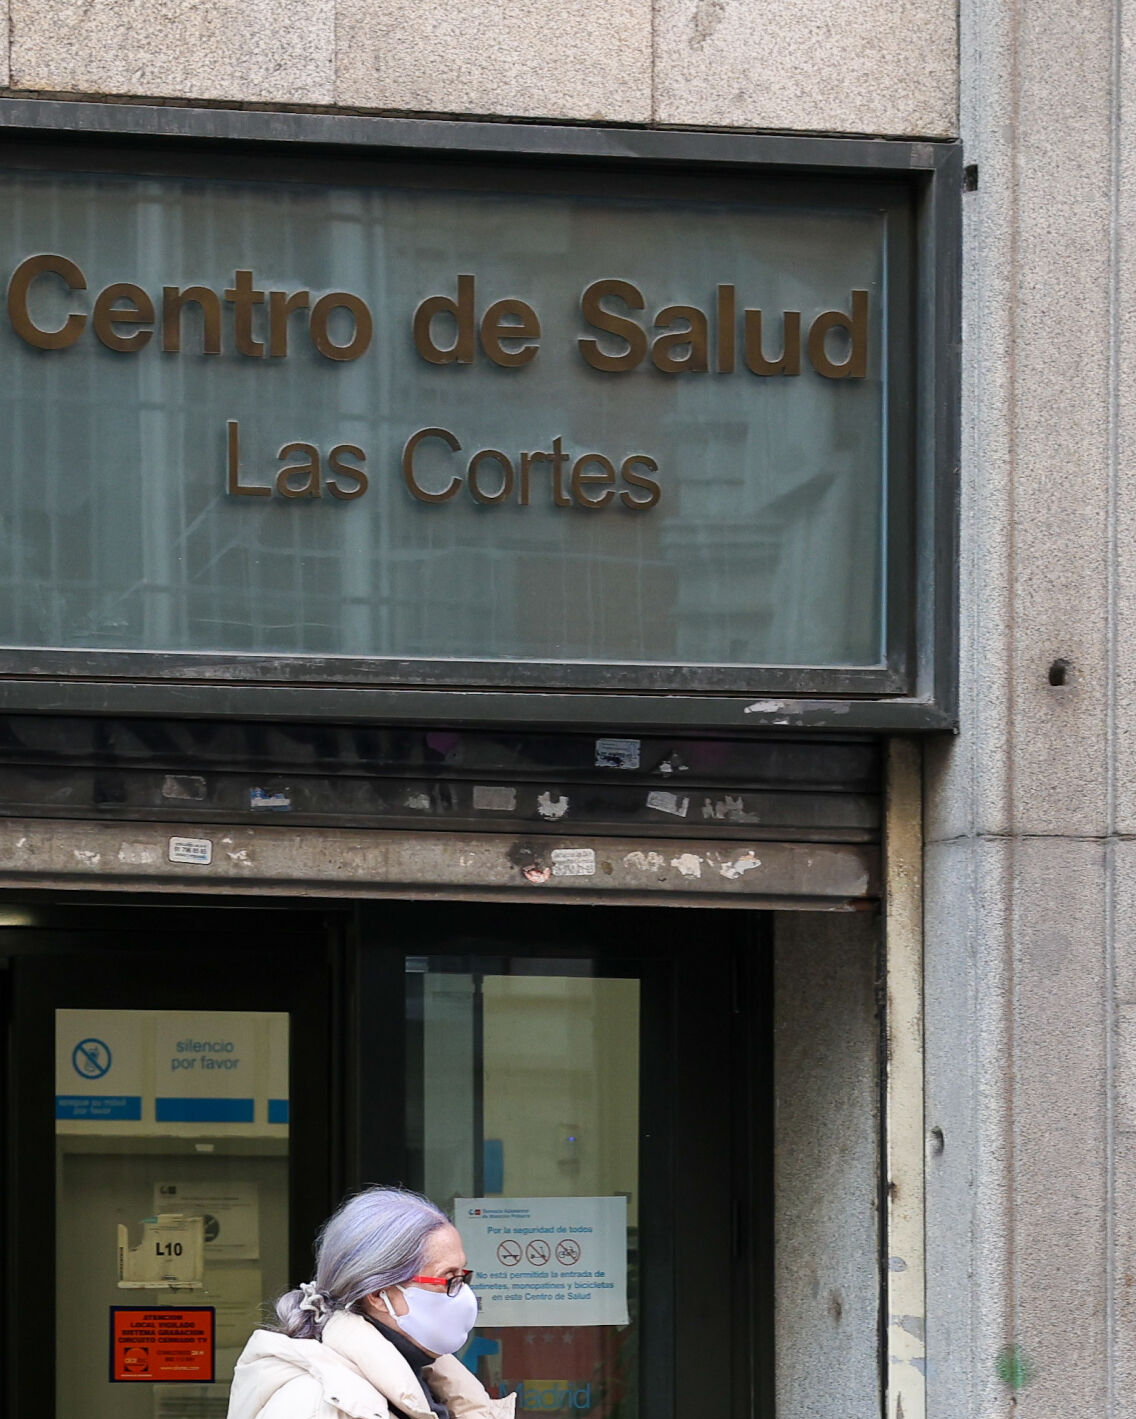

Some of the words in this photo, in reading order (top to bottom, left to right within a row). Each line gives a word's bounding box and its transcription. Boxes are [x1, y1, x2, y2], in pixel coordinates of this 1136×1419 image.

[6, 253, 373, 362] Centro
[413, 274, 542, 369] de
[578, 278, 869, 380] Salud
[226, 420, 369, 501] Las
[401, 426, 662, 511] Cortes
[176, 1039, 234, 1053] silencio
[171, 1058, 197, 1072] por
[200, 1056, 240, 1070] favor
[487, 1226, 502, 1234] Por
[504, 1226, 512, 1234] la
[513, 1225, 554, 1236] seguridad
[156, 1242, 183, 1256] L10
[475, 1271, 488, 1279] No
[560, 1270, 592, 1278] entrada
[594, 1270, 605, 1278] de
[575, 1281, 615, 1289] bicicletas
[524, 1292, 553, 1301] Centro
[555, 1292, 565, 1300] de
[567, 1292, 592, 1300] Salud
